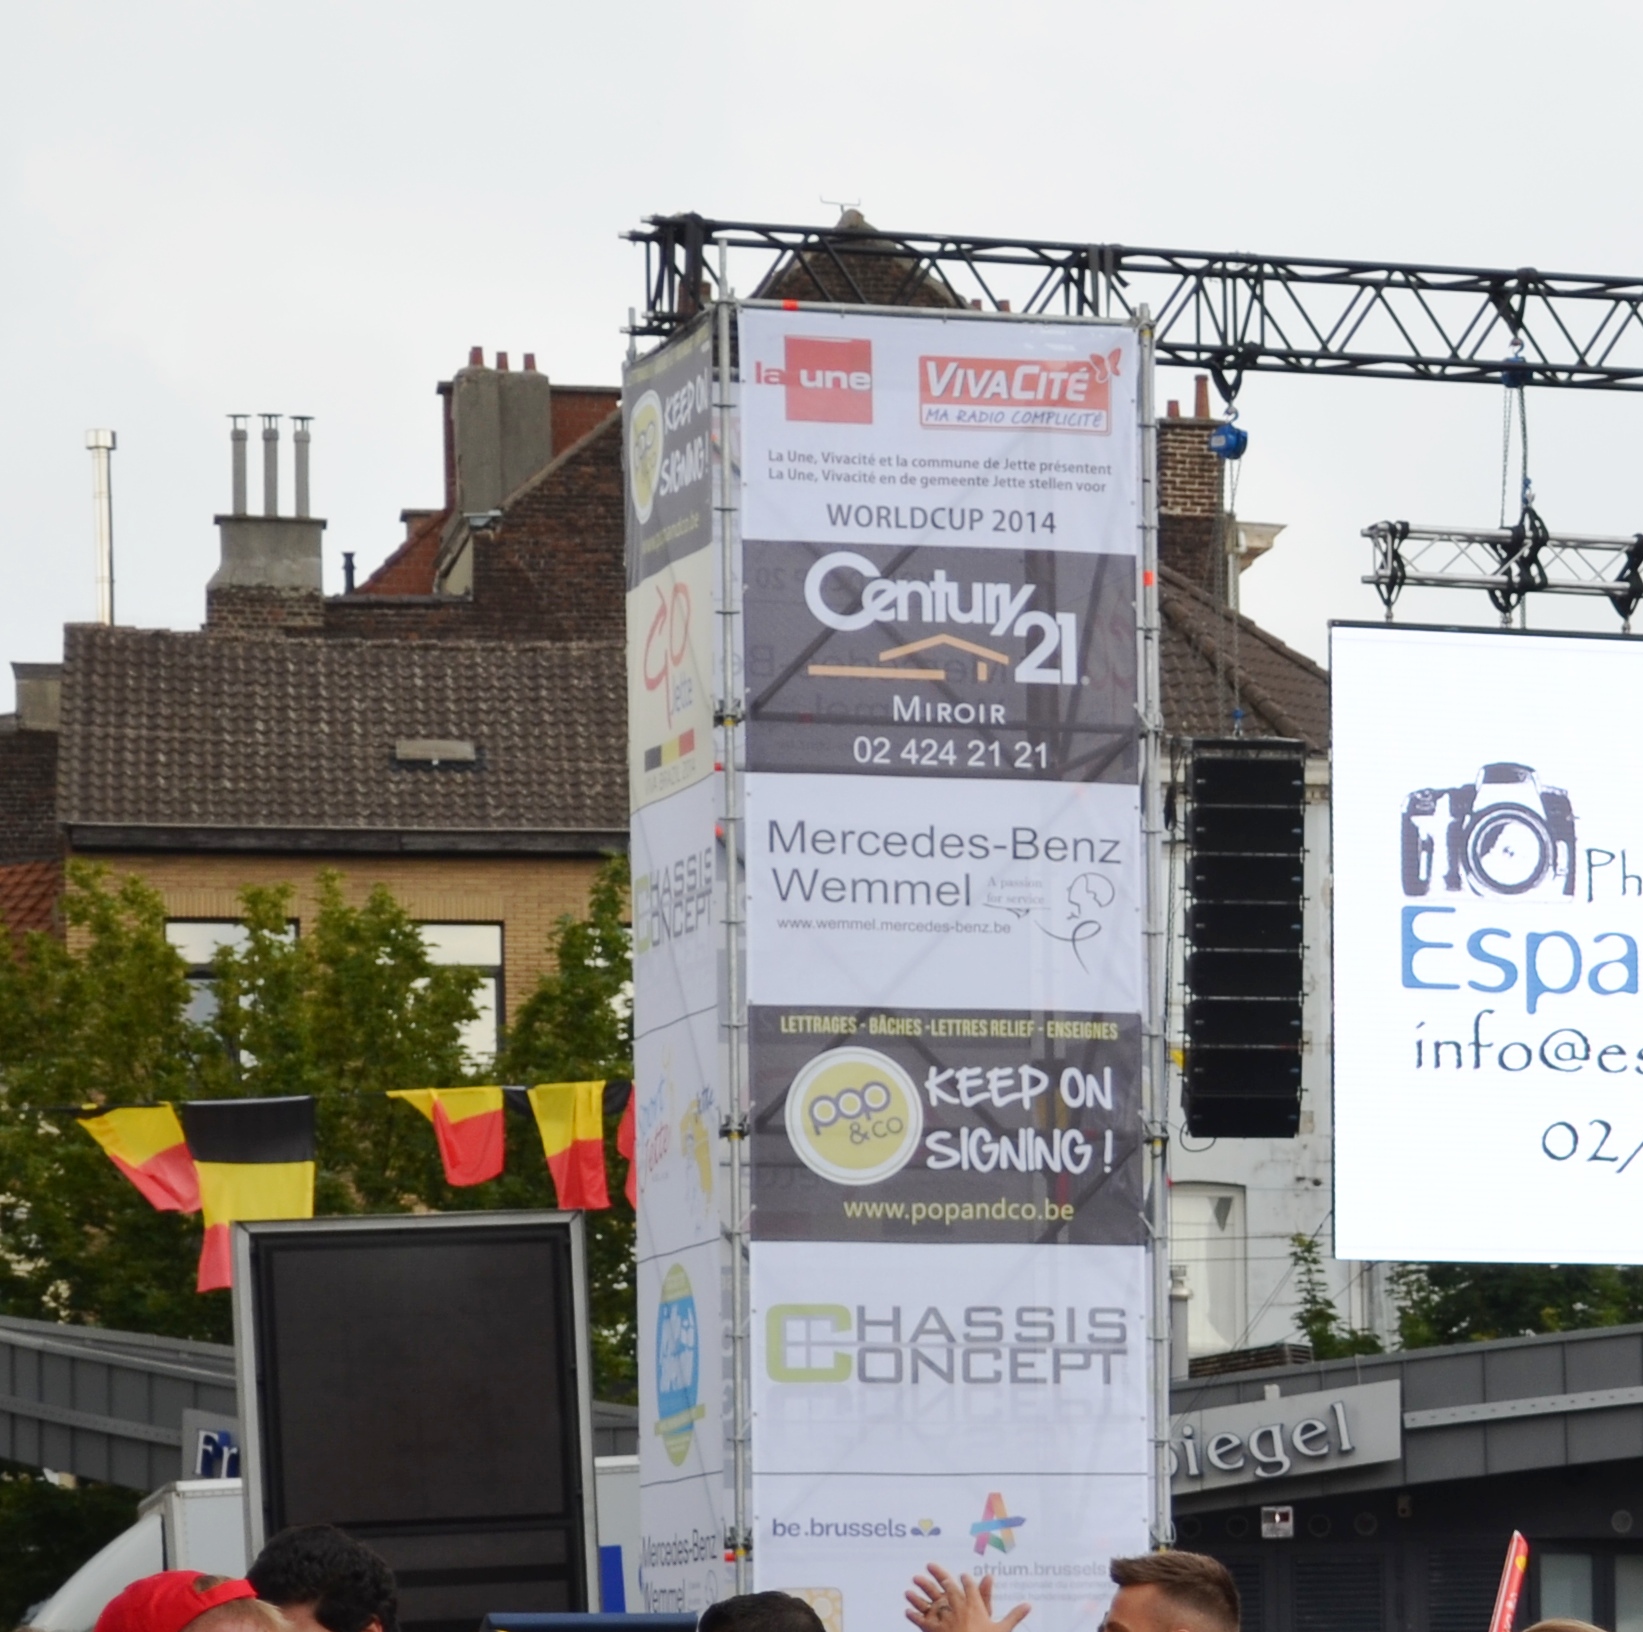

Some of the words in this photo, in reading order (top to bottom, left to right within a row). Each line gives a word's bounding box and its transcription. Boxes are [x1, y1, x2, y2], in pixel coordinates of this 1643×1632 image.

[755, 361, 784, 386] la
[799, 367, 871, 390] une
[925, 408, 953, 423] MA
[956, 409, 1005, 424] RADIO
[768, 450, 784, 463] La
[787, 450, 818, 465] Une,
[821, 452, 875, 466] Vivacité
[879, 455, 892, 466] et
[896, 454, 908, 467] la
[911, 457, 980, 470] commune
[983, 457, 1000, 470] de
[1003, 458, 1036, 472] Jette
[1040, 460, 1112, 476] présentent
[768, 468, 784, 480] La
[787, 469, 818, 483] Une,
[821, 470, 876, 483] Vivacité
[879, 474, 896, 484] en
[900, 473, 917, 485] de
[921, 475, 989, 490] gemeente
[993, 475, 1025, 488] Jette
[1029, 476, 1073, 491] stellen
[1076, 481, 1106, 492] voor
[826, 503, 984, 531] WORLDCUP
[992, 510, 1057, 534] 2014
[804, 551, 1036, 636] Century
[1013, 610, 1078, 685] 21
[853, 736, 890, 764] 02
[900, 739, 957, 766] 424
[967, 740, 1000, 768] 21
[1013, 741, 1047, 769] 21
[768, 819, 1122, 864] Mercedes-Benz
[772, 868, 971, 907] Wemmel
[1000, 877, 1043, 891] passion
[1005, 894, 1045, 905] service
[777, 917, 1011, 934] www.wemmel.mercedes-benz.be
[781, 1015, 857, 1034] LETTRAGES
[869, 1014, 922, 1036] BÂCHES
[991, 1020, 1035, 1038] RELIEF
[1047, 1021, 1118, 1040] ENSEIGNES
[924, 1065, 1050, 1110] KEEP
[1060, 1066, 1112, 1110] ON
[926, 1126, 1093, 1175] SIGNING
[843, 1197, 1075, 1225] www.popandco.be
[642, 1529, 717, 1568] Mercedes-Benz
